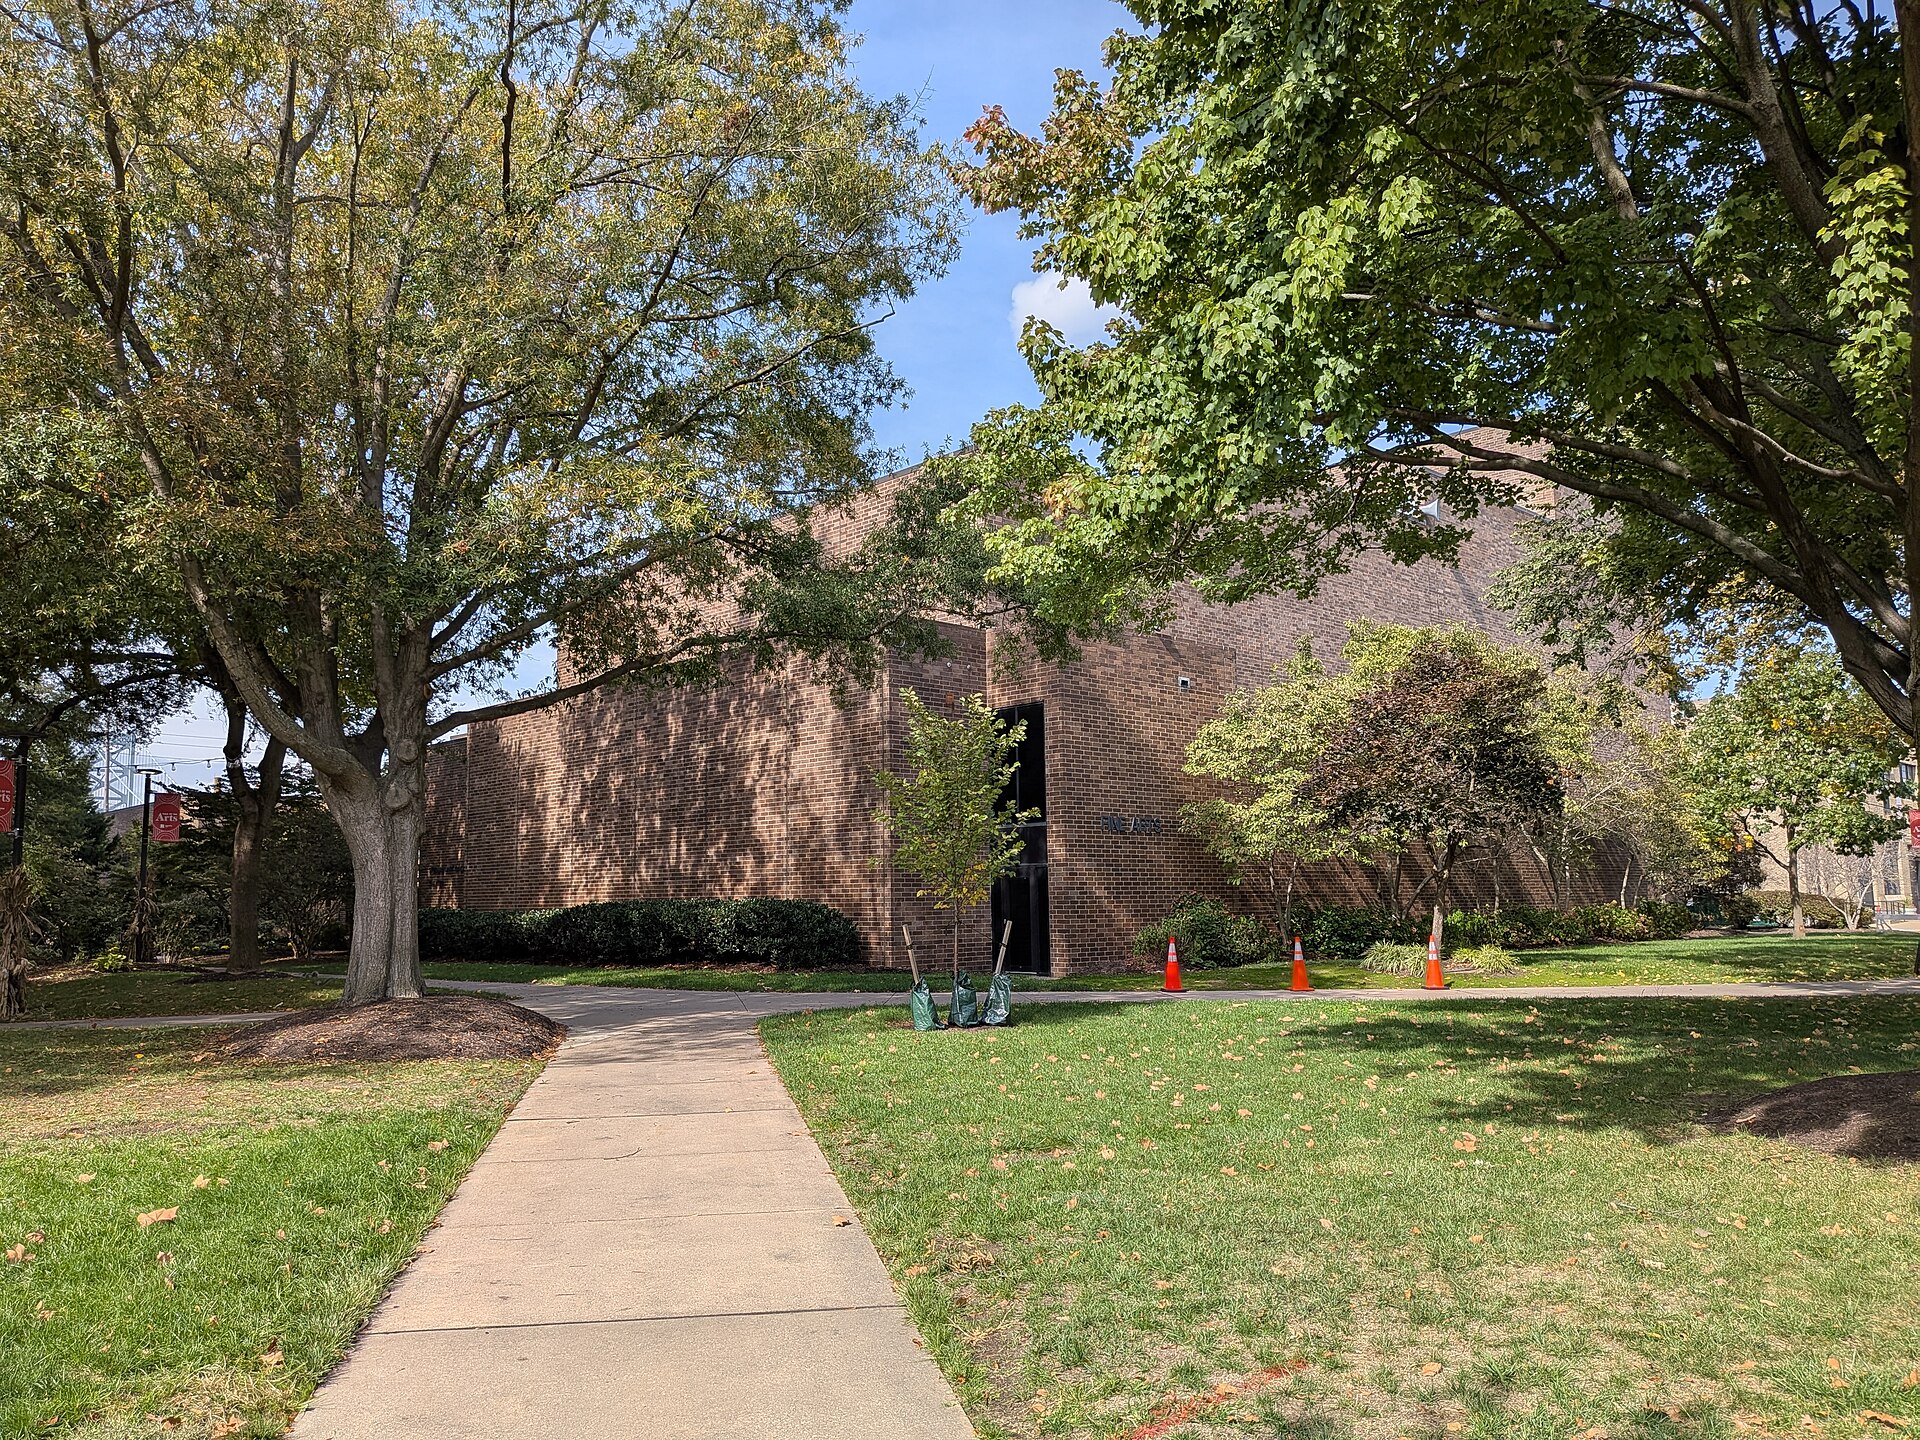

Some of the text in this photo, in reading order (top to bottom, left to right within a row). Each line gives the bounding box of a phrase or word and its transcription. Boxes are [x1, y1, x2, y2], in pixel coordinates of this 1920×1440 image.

[155, 813, 178, 822] Arts
[1101, 816, 1161, 833] FINE ARTS
